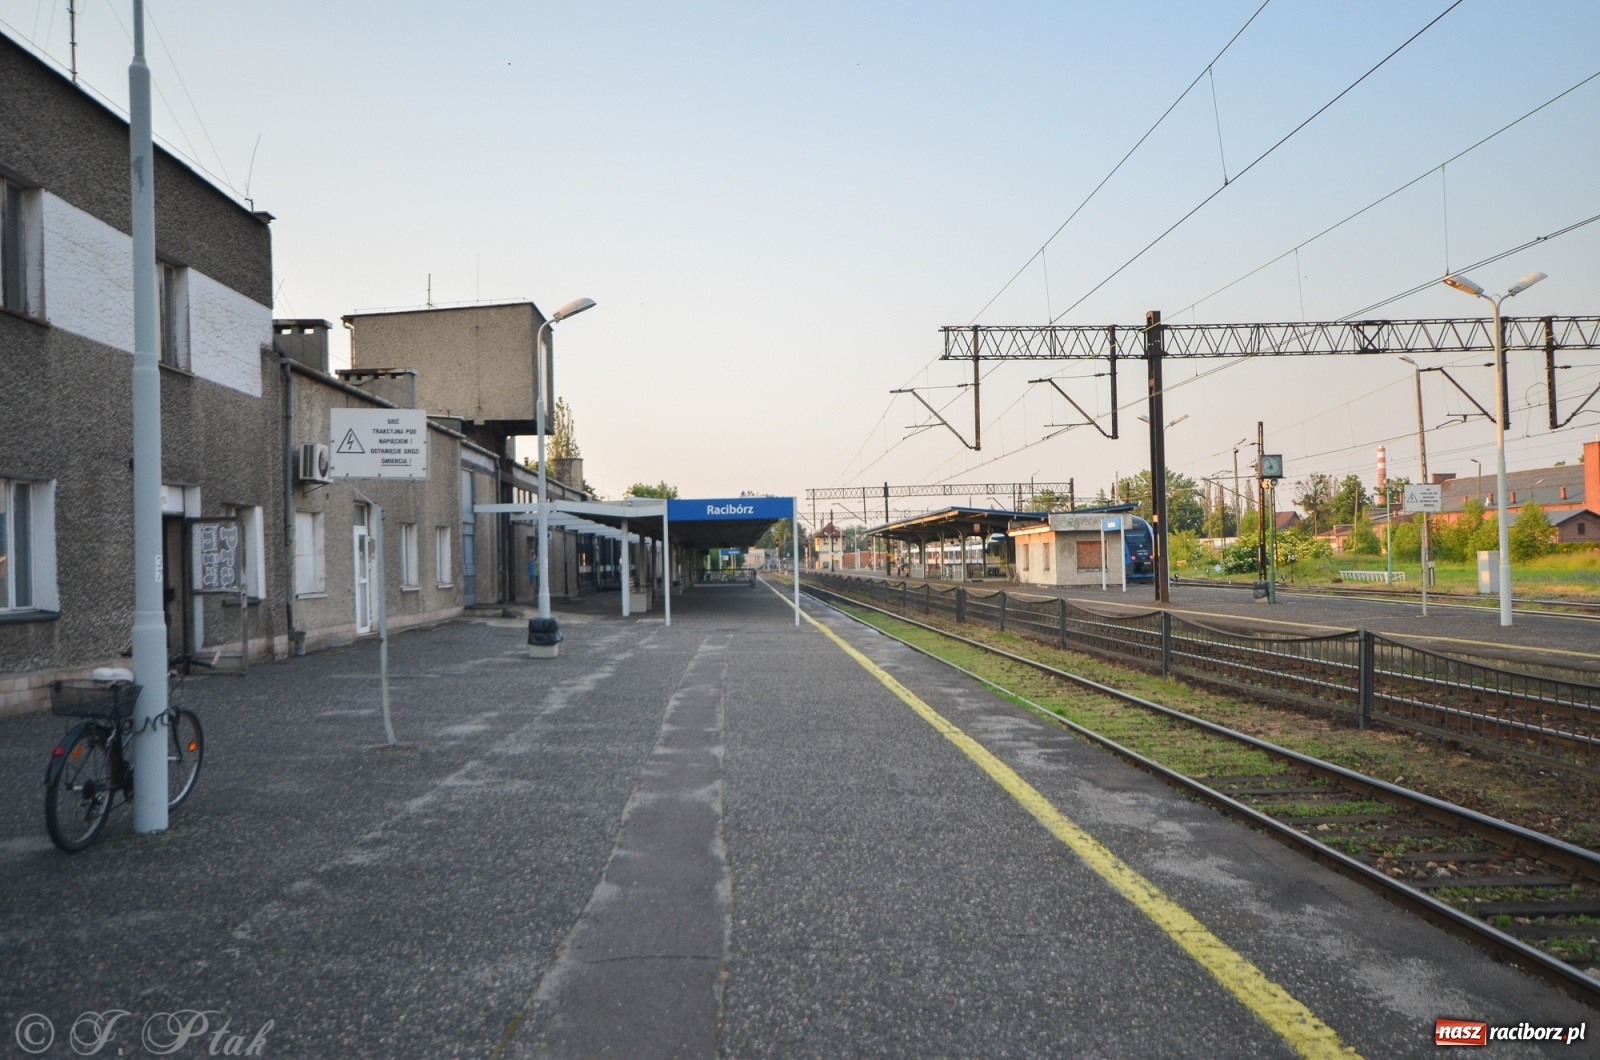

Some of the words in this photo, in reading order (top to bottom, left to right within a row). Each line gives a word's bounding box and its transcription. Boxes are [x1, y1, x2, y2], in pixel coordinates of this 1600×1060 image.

[387, 417, 400, 425] SIEĆ
[378, 438, 408, 446] NAPIĘCIEM
[706, 503, 754, 515] Racibórz
